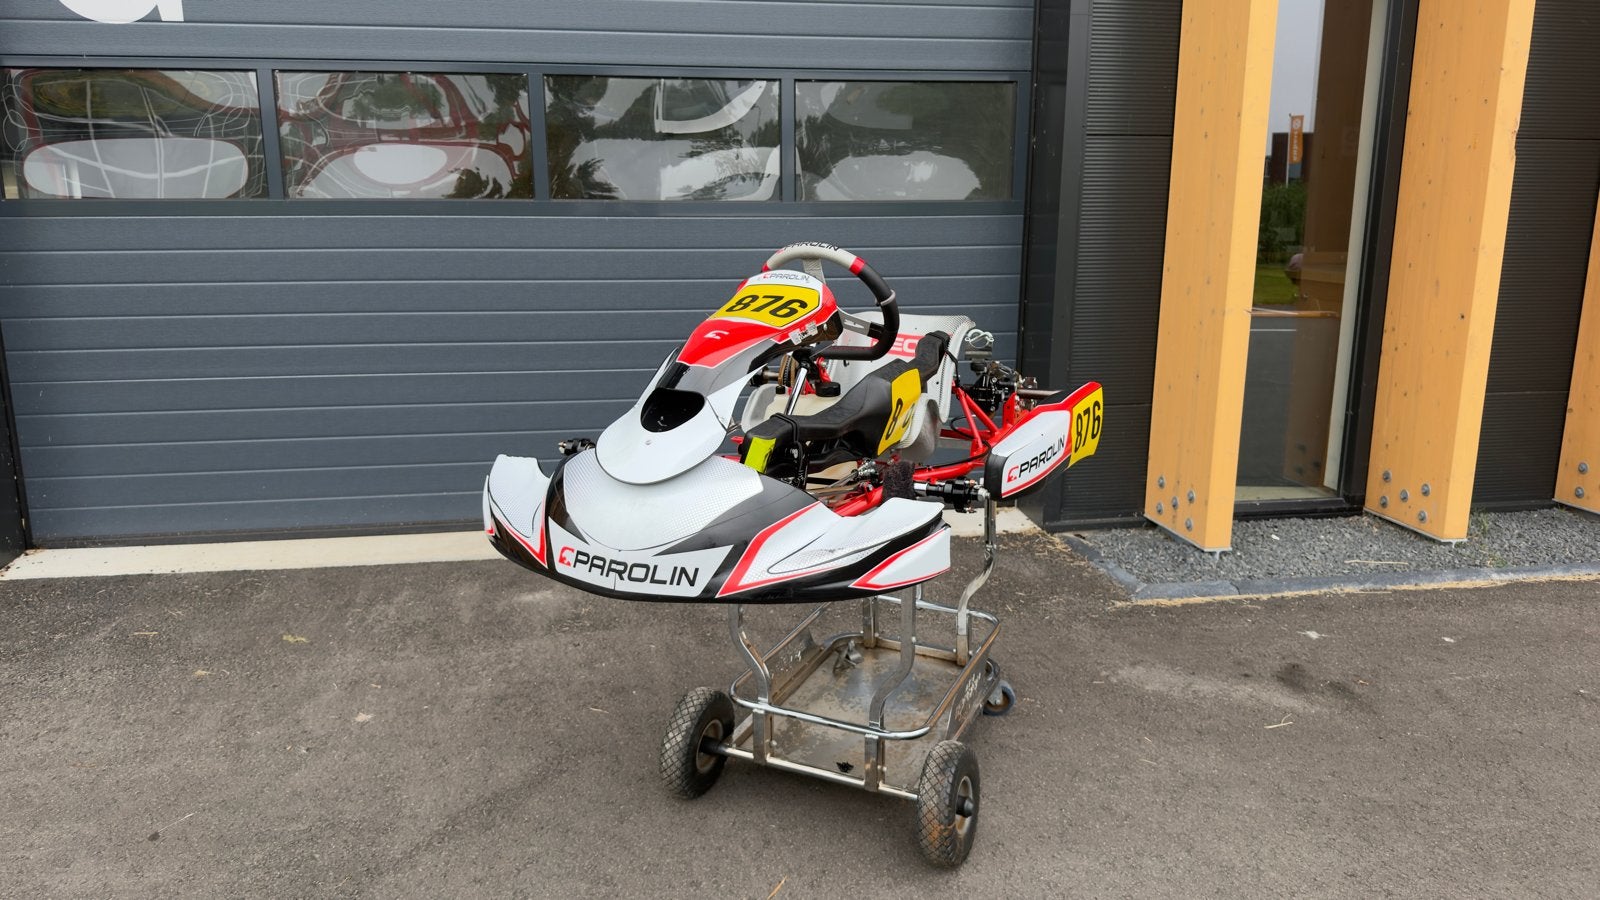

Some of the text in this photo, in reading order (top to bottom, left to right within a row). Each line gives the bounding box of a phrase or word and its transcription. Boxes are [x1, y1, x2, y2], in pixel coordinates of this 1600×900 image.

[726, 295, 808, 318] 876
[1074, 400, 1101, 453] 876
[1018, 434, 1066, 478] PAROLIN
[573, 549, 700, 587] PAROLIN
